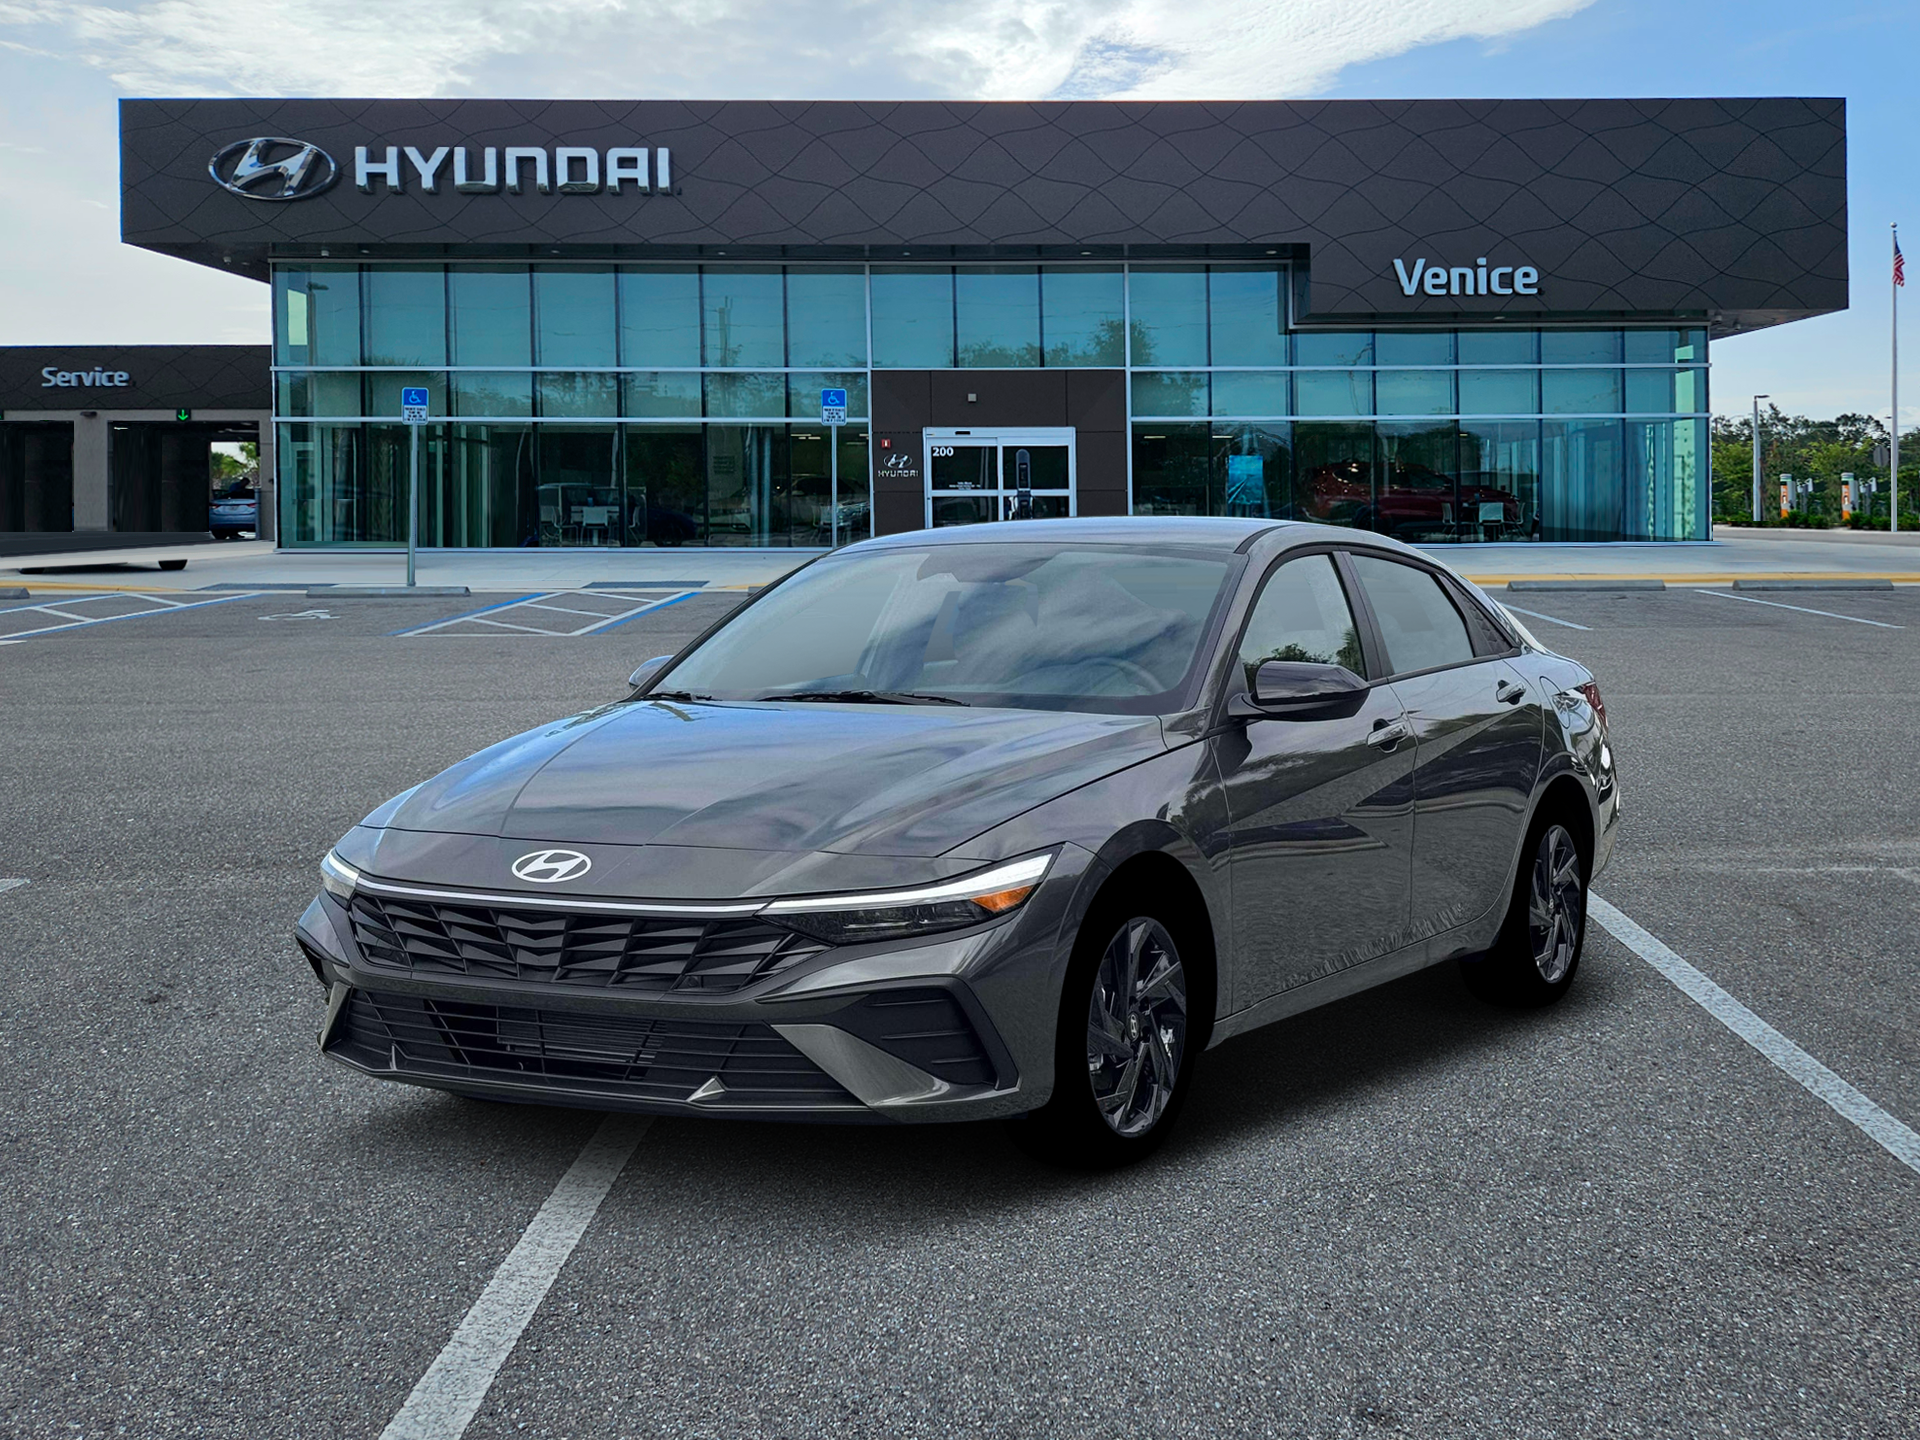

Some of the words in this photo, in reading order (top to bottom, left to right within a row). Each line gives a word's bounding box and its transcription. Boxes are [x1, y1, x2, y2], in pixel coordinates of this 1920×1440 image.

[355, 146, 670, 194] HYUNDAI
[1393, 257, 1539, 296] Venice
[41, 366, 130, 387] Service
[932, 446, 954, 457] 200
[877, 470, 919, 478] HYUNDAI
